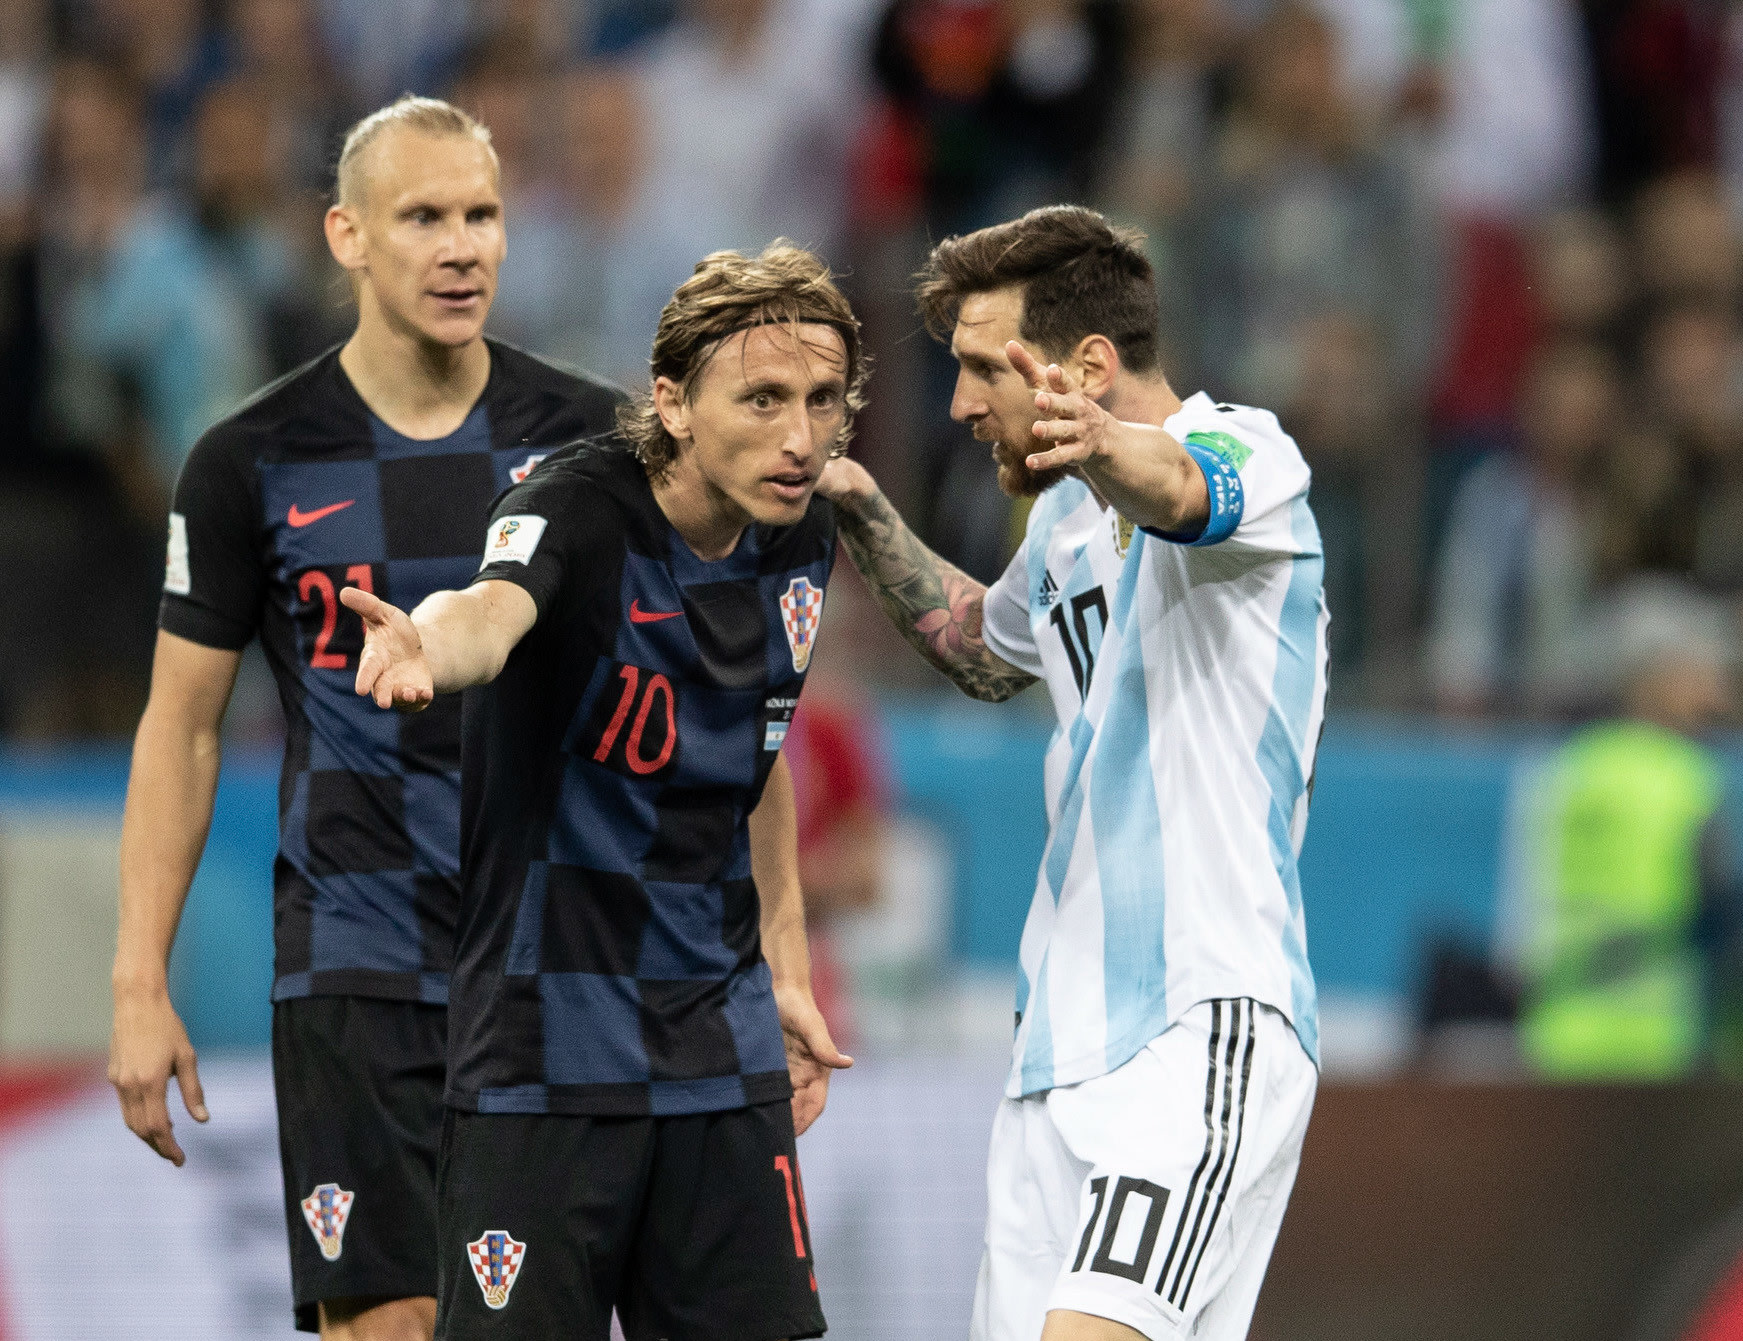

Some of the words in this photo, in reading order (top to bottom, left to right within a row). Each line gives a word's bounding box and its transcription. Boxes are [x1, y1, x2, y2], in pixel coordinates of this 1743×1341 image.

[1213, 474, 1225, 515] FIFA
[1050, 584, 1109, 706] 10
[593, 664, 677, 774] 10
[774, 1155, 808, 1258] 1
[1071, 1175, 1171, 1284] 10
